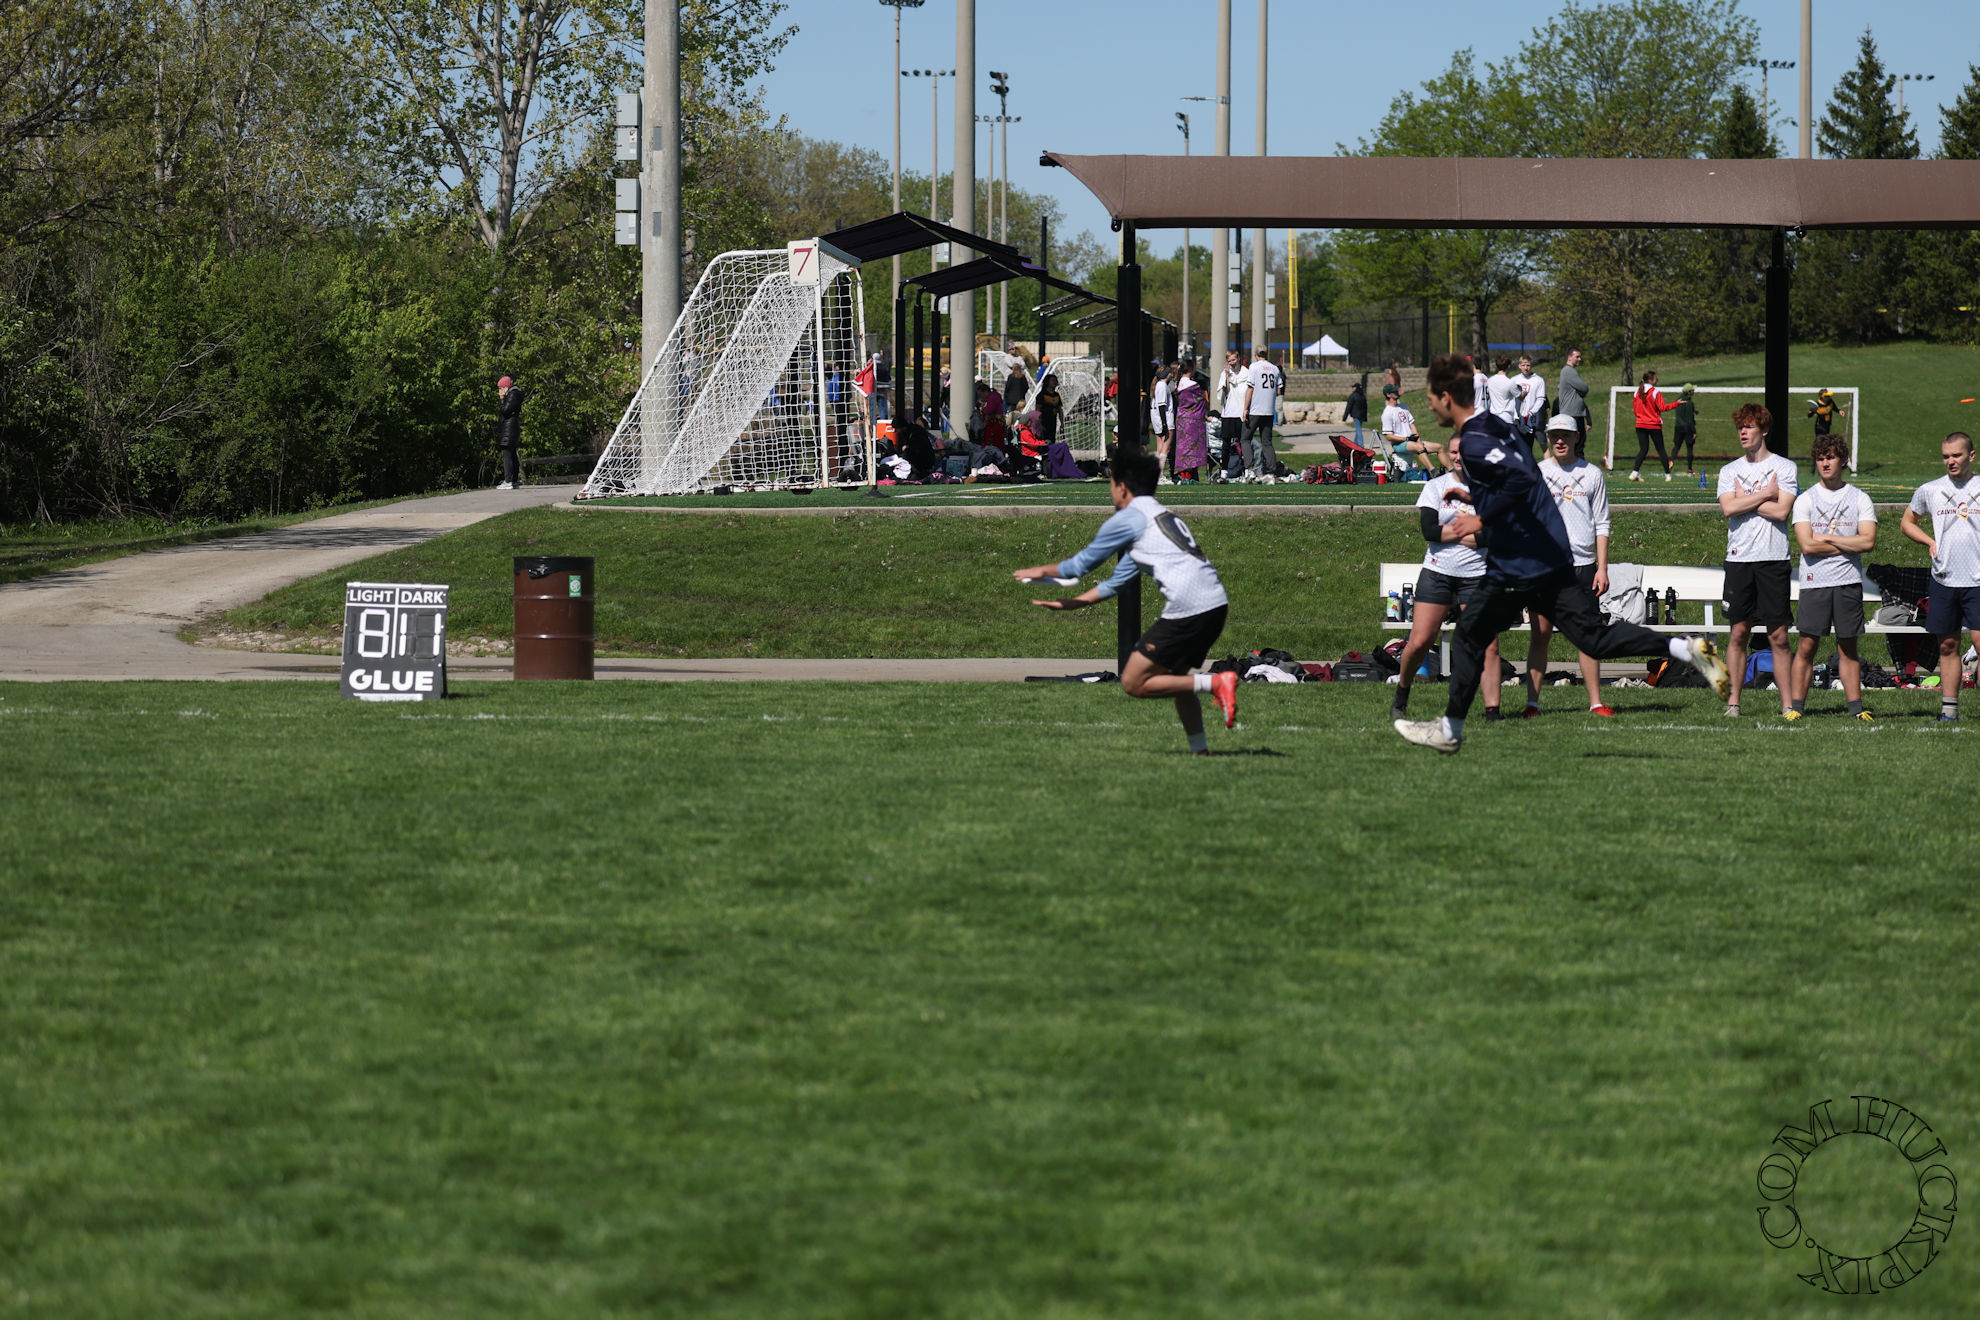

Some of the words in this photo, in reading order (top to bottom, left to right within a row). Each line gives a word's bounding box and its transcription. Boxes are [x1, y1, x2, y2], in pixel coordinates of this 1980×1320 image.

[793, 247, 813, 276] 7
[1261, 373, 1275, 389] 26
[1936, 508, 1957, 516] CALVIN
[1173, 516, 1197, 548] 9
[349, 589, 394, 603] LIGHT
[401, 590, 444, 604] DARK
[357, 608, 390, 658] 8
[398, 612, 441, 656] 11
[349, 668, 434, 692] GLUE
